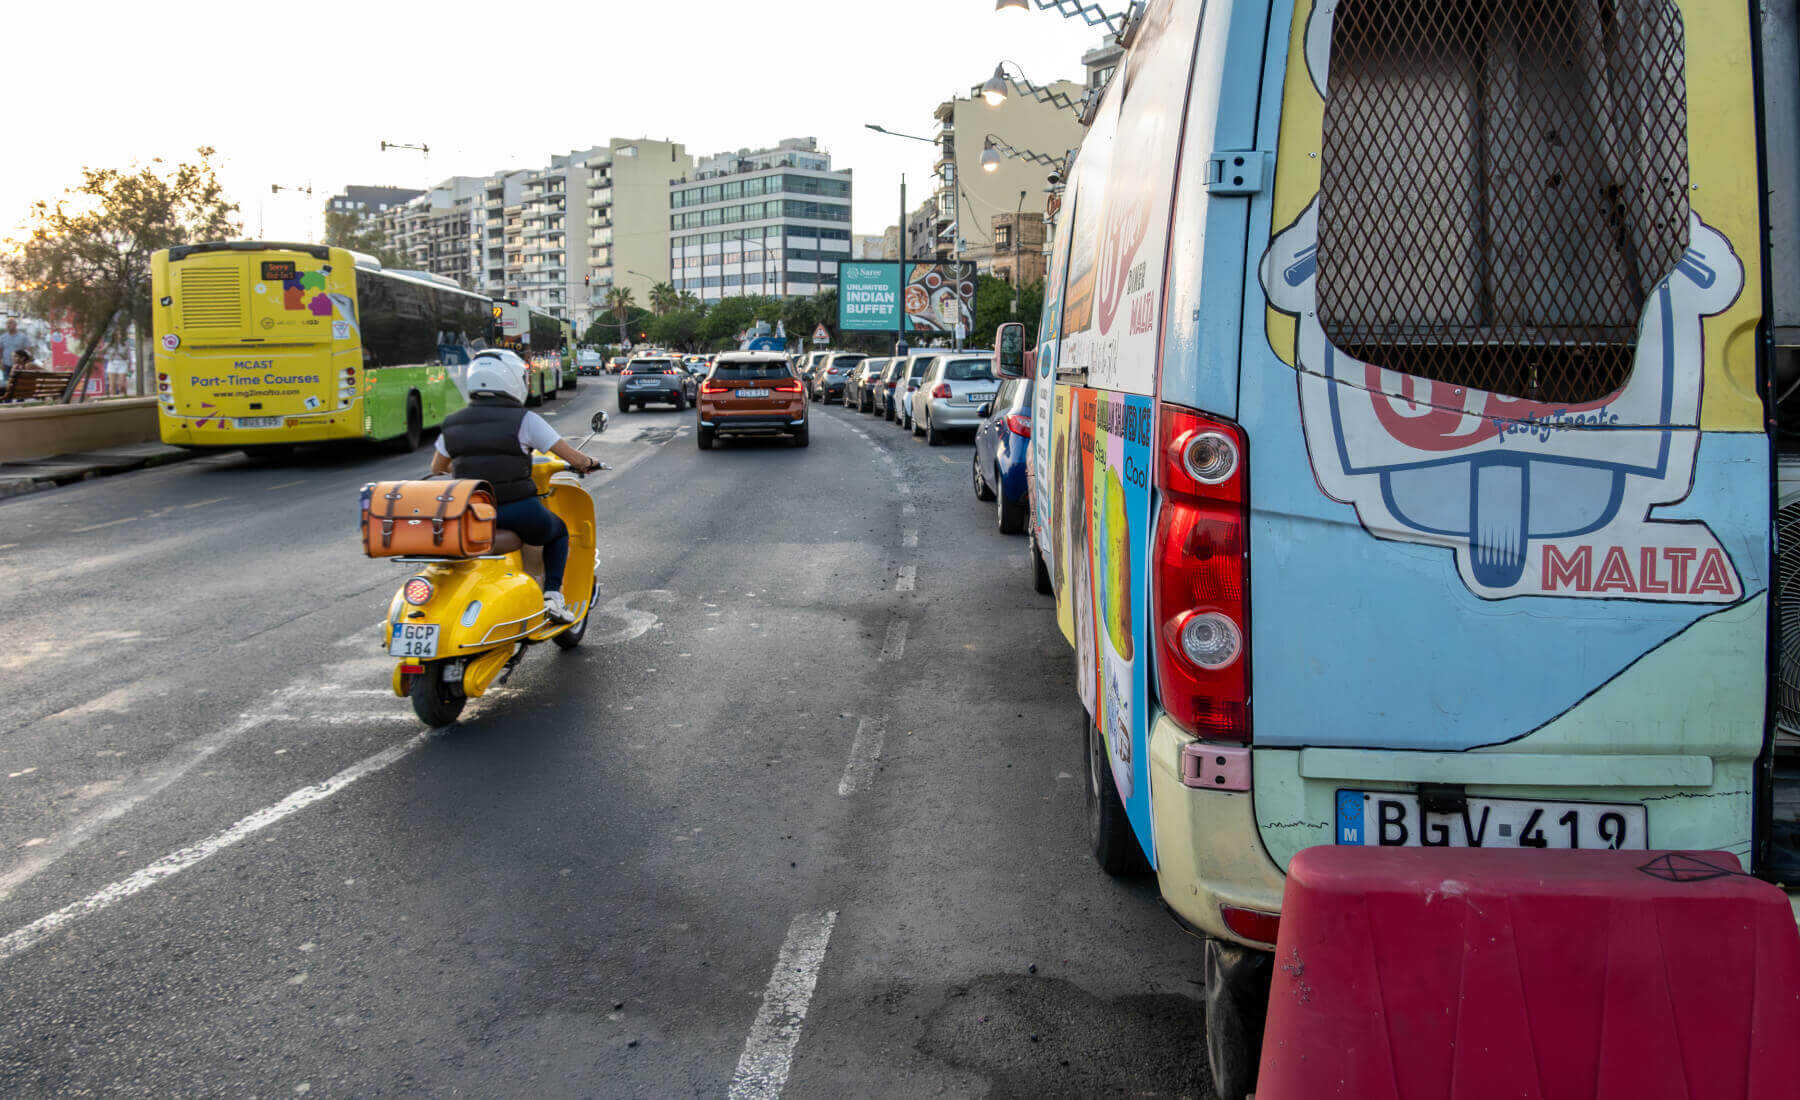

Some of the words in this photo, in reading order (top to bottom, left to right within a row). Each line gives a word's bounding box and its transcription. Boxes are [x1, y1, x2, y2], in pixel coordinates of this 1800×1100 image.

[846, 292, 895, 303] INDIAN
[846, 304, 895, 314] BUFFET
[234, 360, 274, 369] MCAST
[191, 374, 261, 387] Part-Time
[264, 373, 320, 385] Courses
[1138, 407, 1152, 448] ICE
[1493, 411, 1551, 443] Tasty
[1125, 456, 1148, 491] Cool
[1541, 545, 1735, 595] MALTA
[405, 626, 434, 640] GCP
[404, 641, 432, 655] 184
[1344, 828, 1358, 842] M
[1378, 800, 1490, 849] BGV
[1519, 809, 1627, 850] 419
